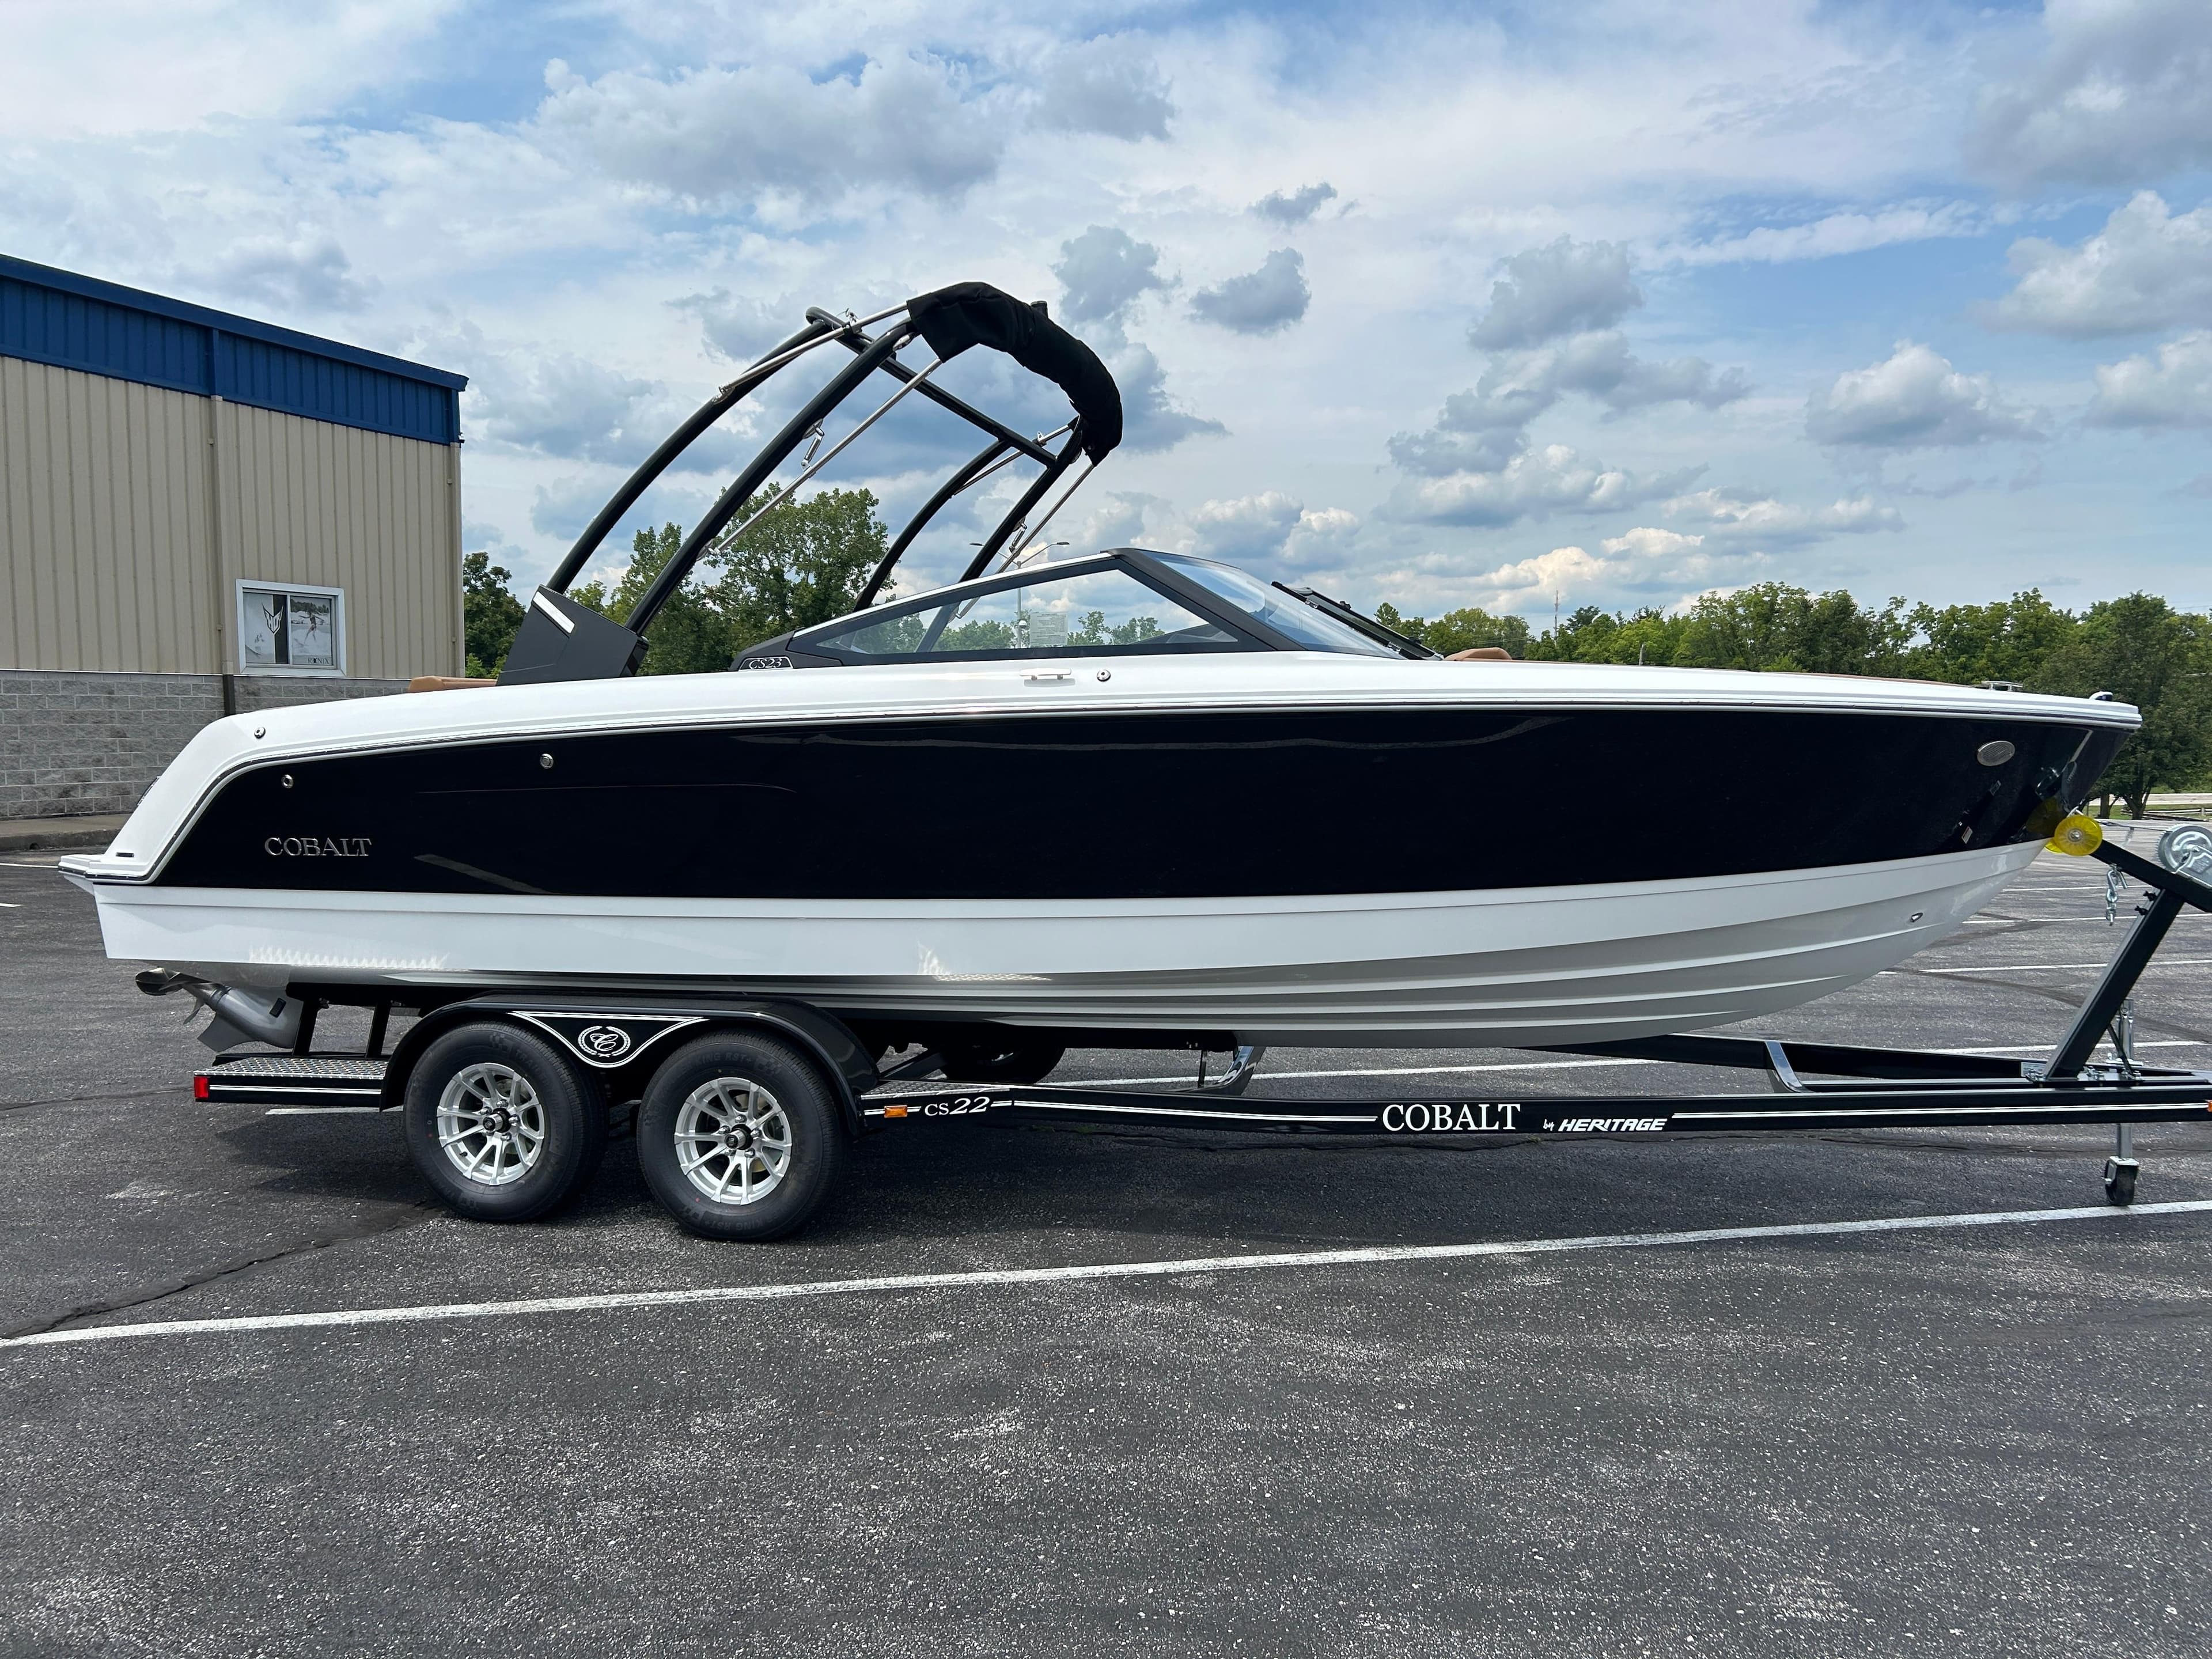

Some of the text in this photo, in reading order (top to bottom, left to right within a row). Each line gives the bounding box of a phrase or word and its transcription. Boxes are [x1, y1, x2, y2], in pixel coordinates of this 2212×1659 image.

[748, 658, 782, 669] CS23
[264, 837, 372, 857] COBALT
[924, 1096, 990, 1116] CS22
[1382, 1103, 1668, 1132] COBALT by HERITAGE
